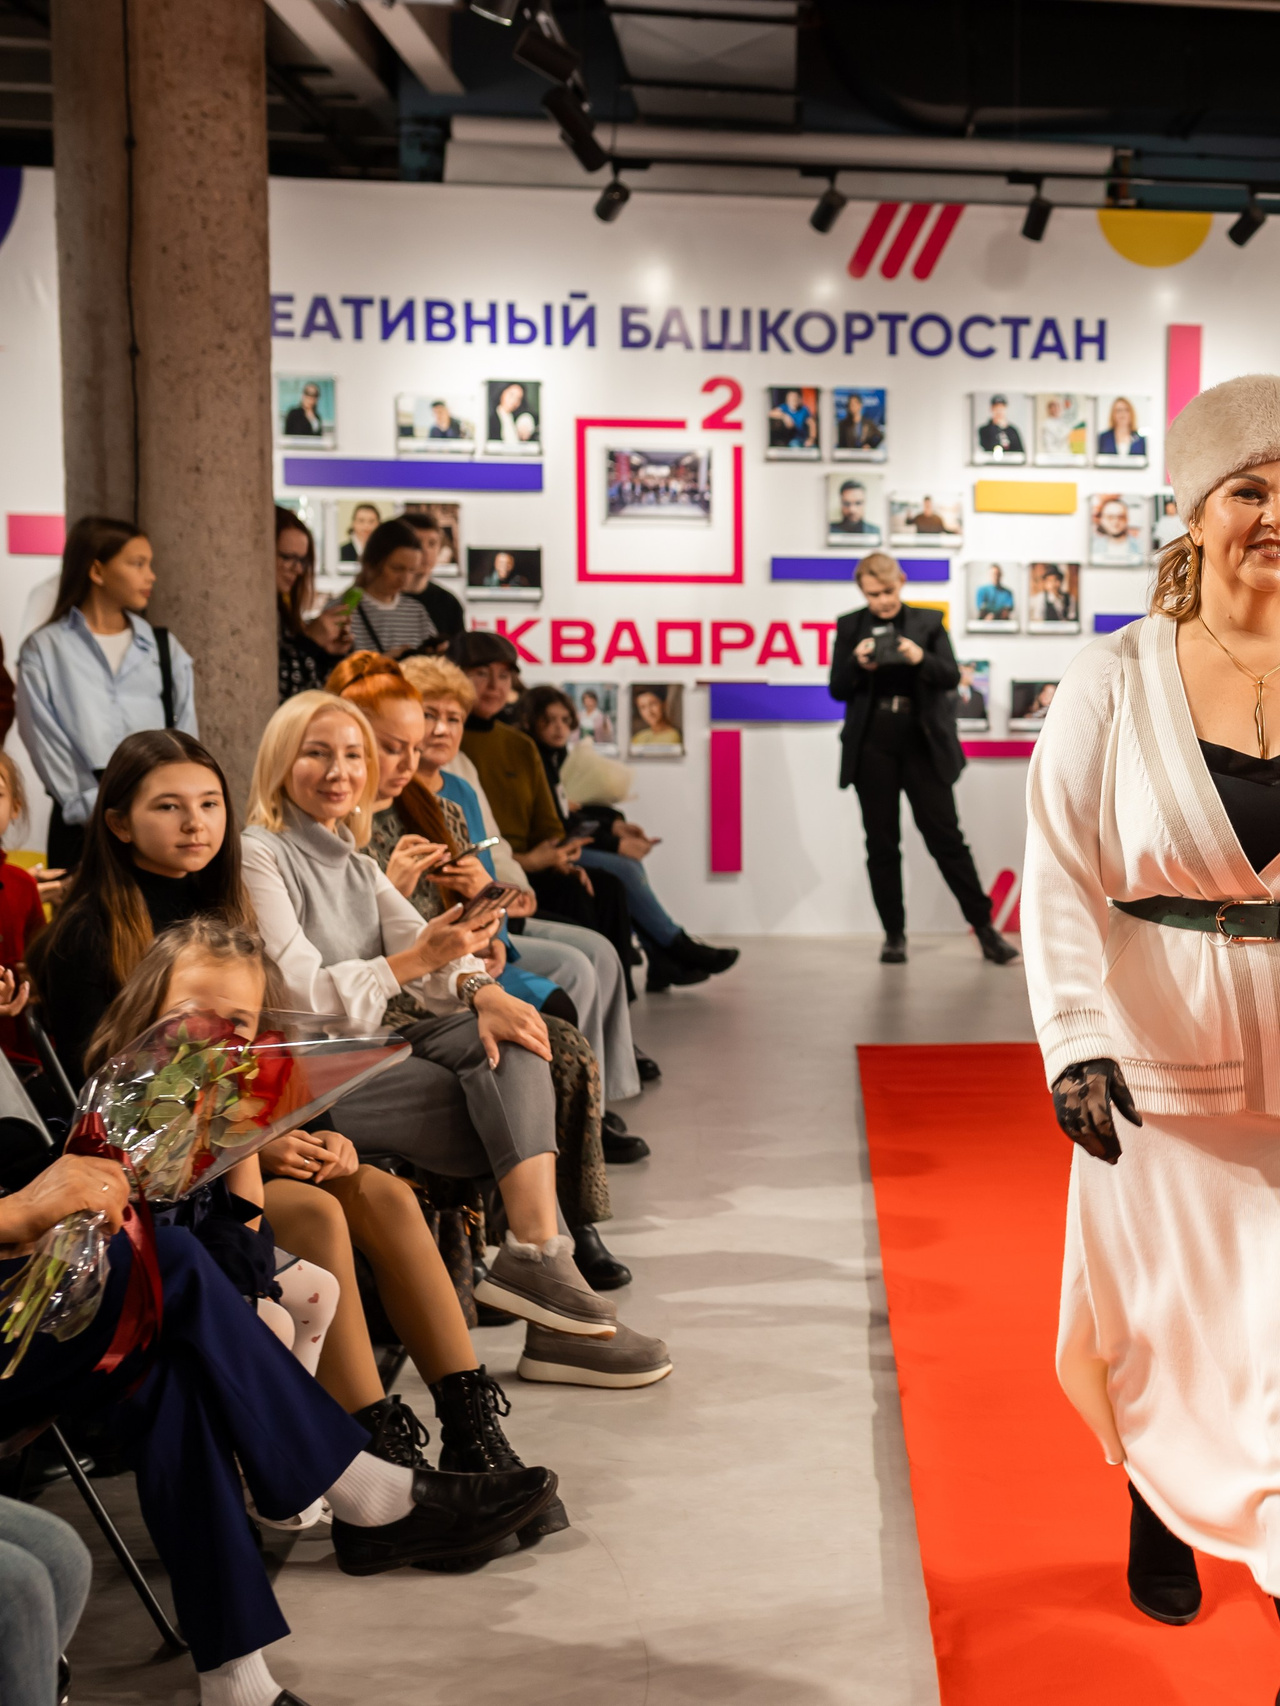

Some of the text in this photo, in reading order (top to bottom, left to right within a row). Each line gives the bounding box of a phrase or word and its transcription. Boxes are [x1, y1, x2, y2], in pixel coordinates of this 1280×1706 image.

[271, 292, 1107, 361] ЕАТИВНЫЙ БАШКОРТОСТАН
[701, 376, 743, 430] 2
[496, 619, 837, 665] КВАДРАТ
